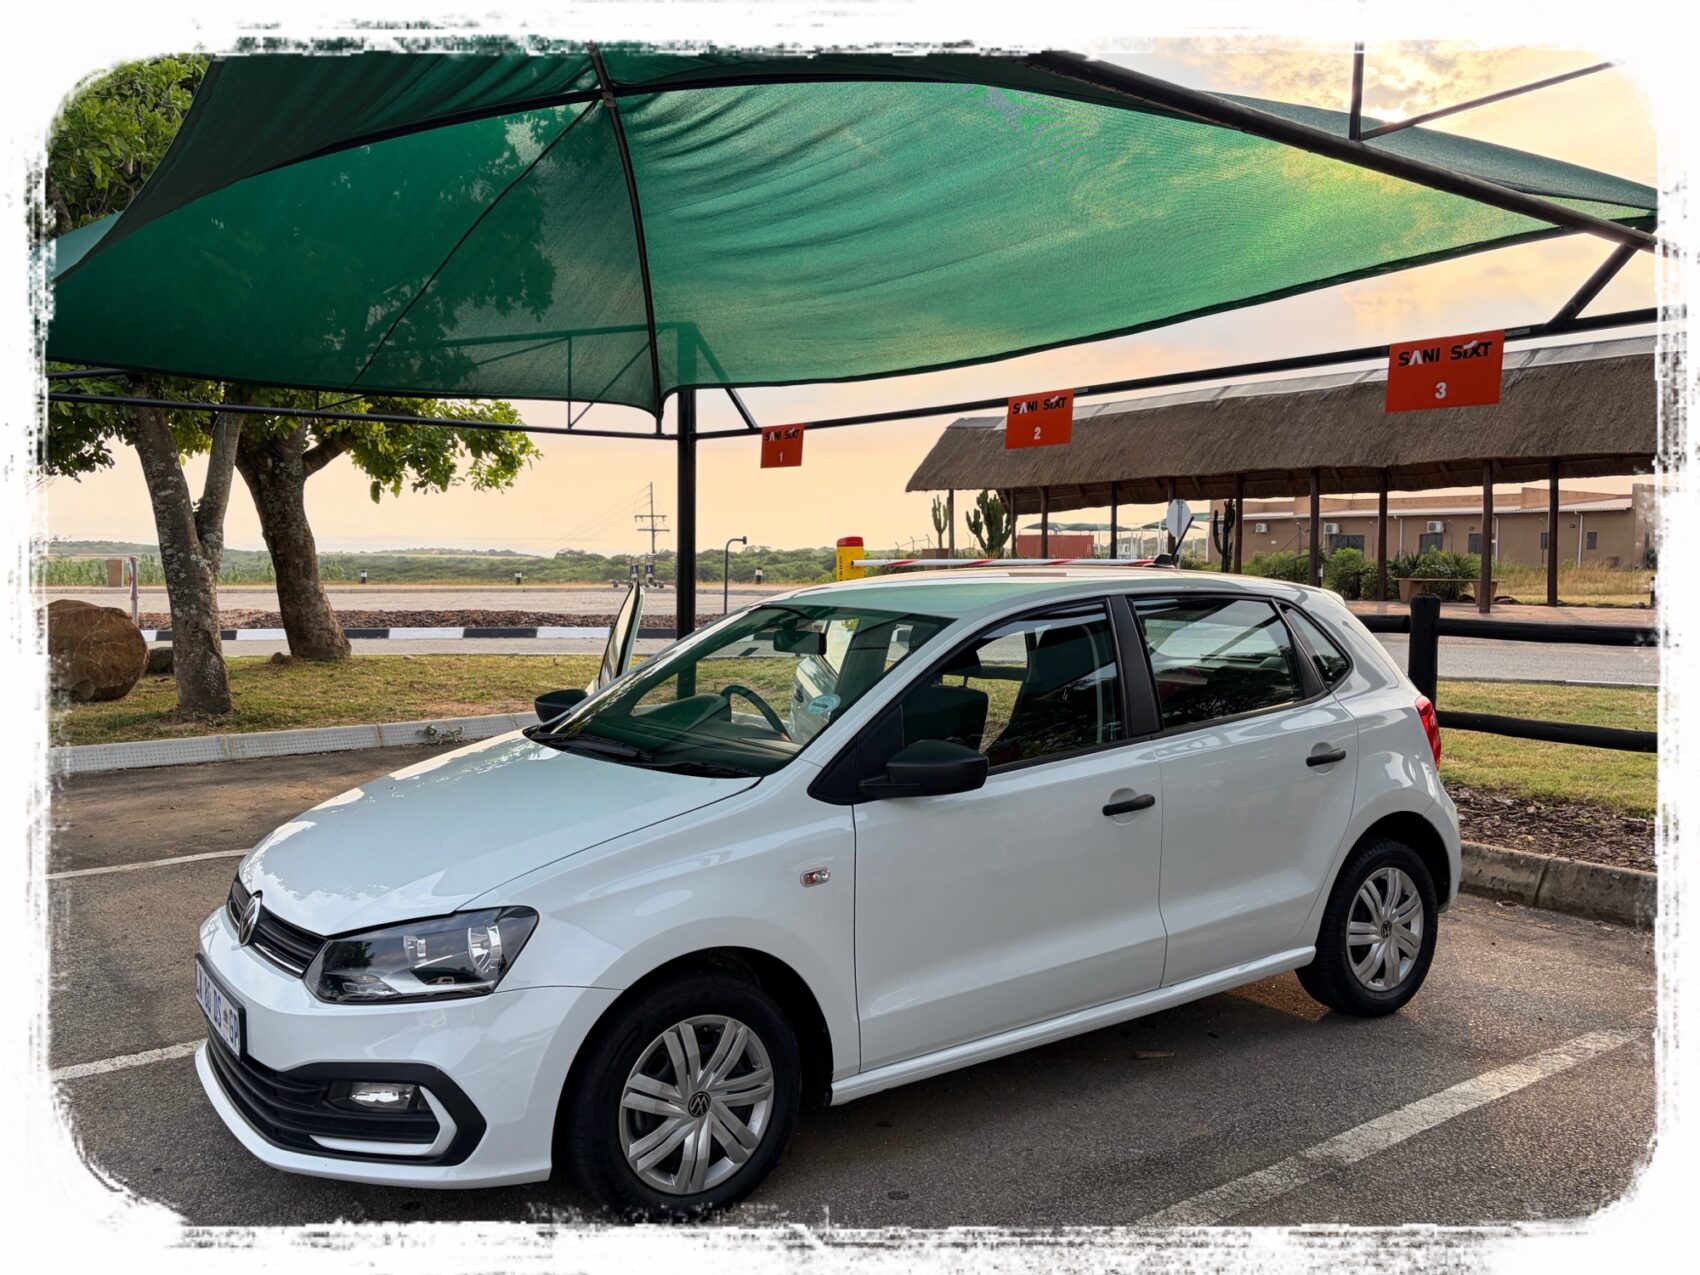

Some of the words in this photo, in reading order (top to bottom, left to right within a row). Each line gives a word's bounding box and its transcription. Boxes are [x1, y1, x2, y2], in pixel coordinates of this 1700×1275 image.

[1398, 347, 1441, 366] SANI
[1434, 382, 1447, 399] 3
[1012, 400, 1038, 415] SANI
[1033, 426, 1041, 440] 2
[779, 451, 784, 463] 1
